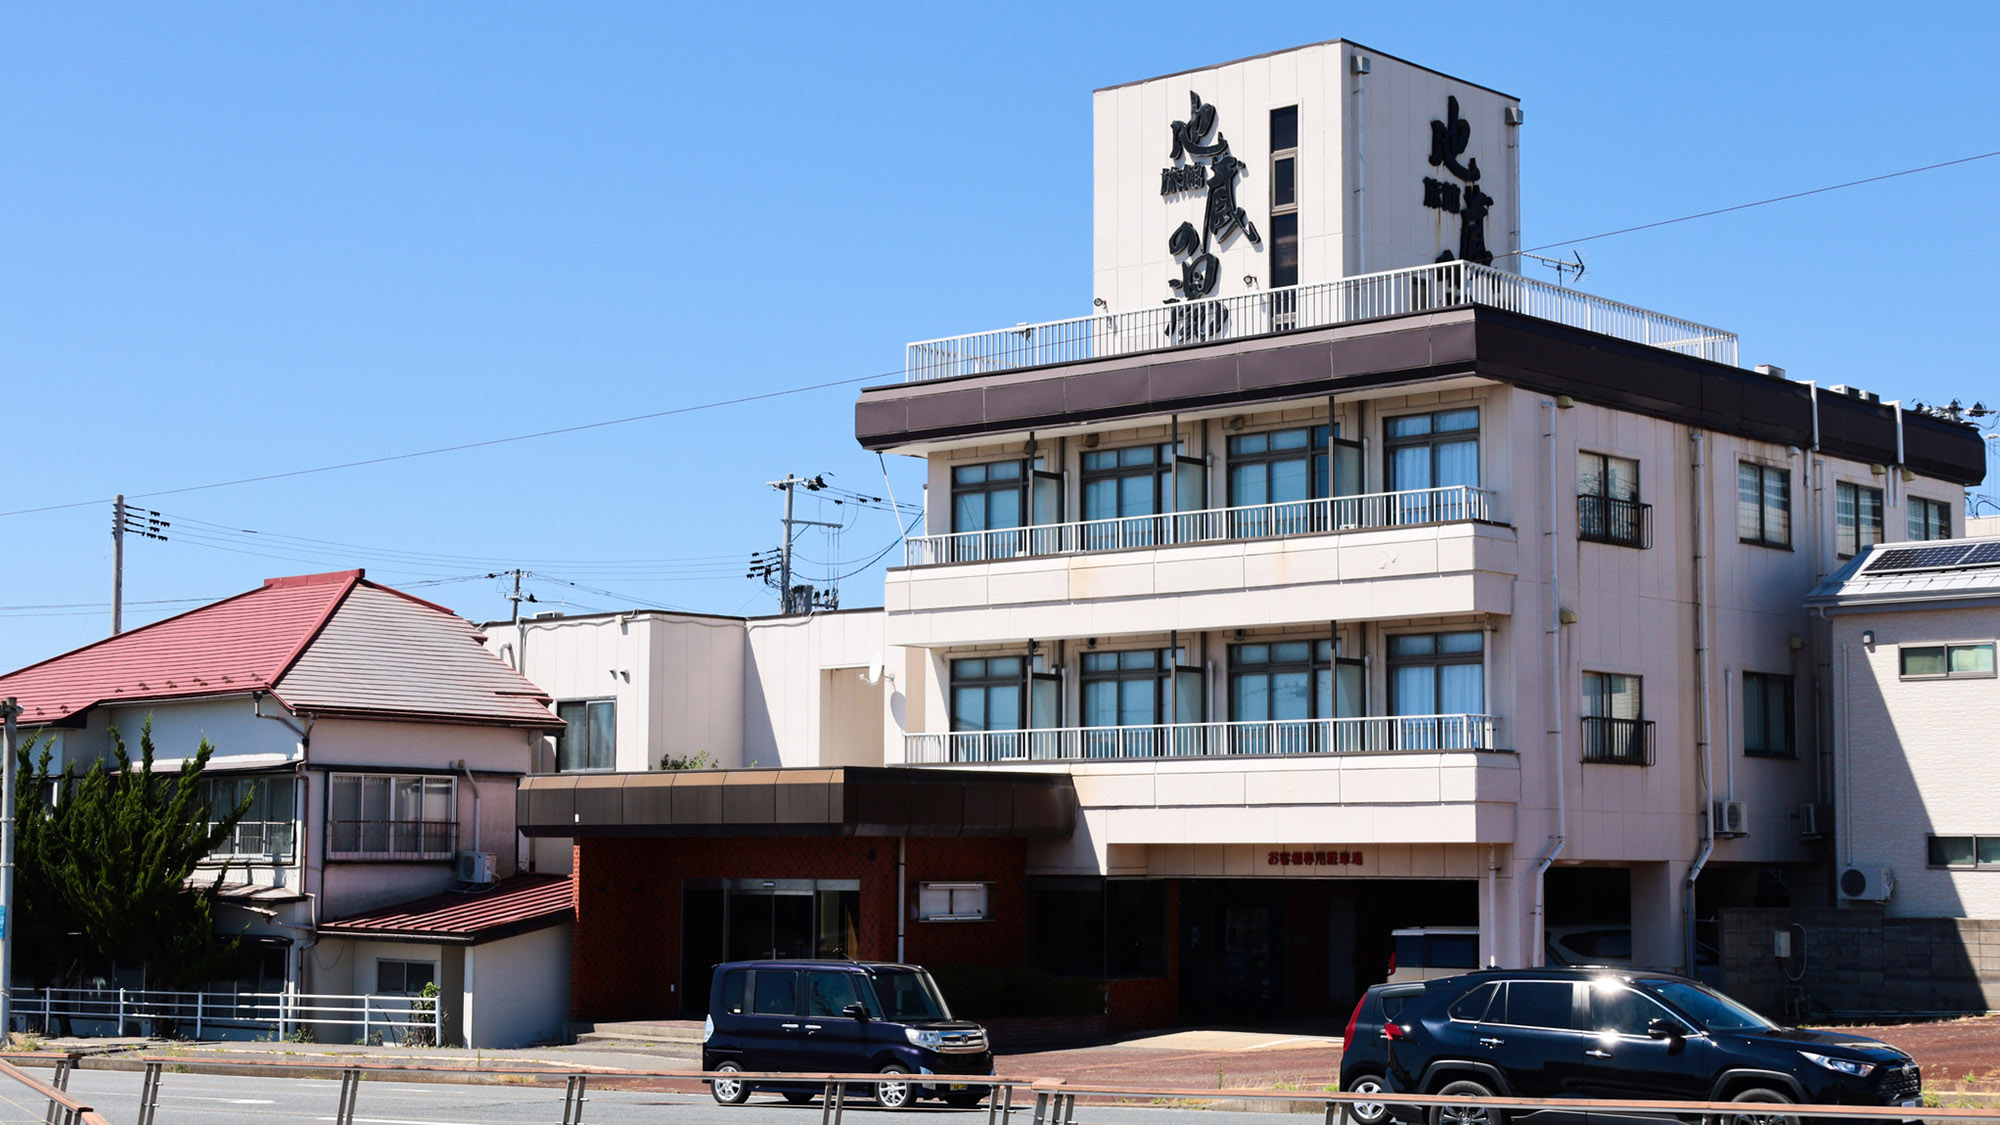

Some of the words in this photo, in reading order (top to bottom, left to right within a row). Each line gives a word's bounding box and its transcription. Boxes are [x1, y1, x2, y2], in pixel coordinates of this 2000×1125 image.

[1161, 162, 1206, 196] 旅館
[1268, 851, 1363, 866] お客様専用駐車場
